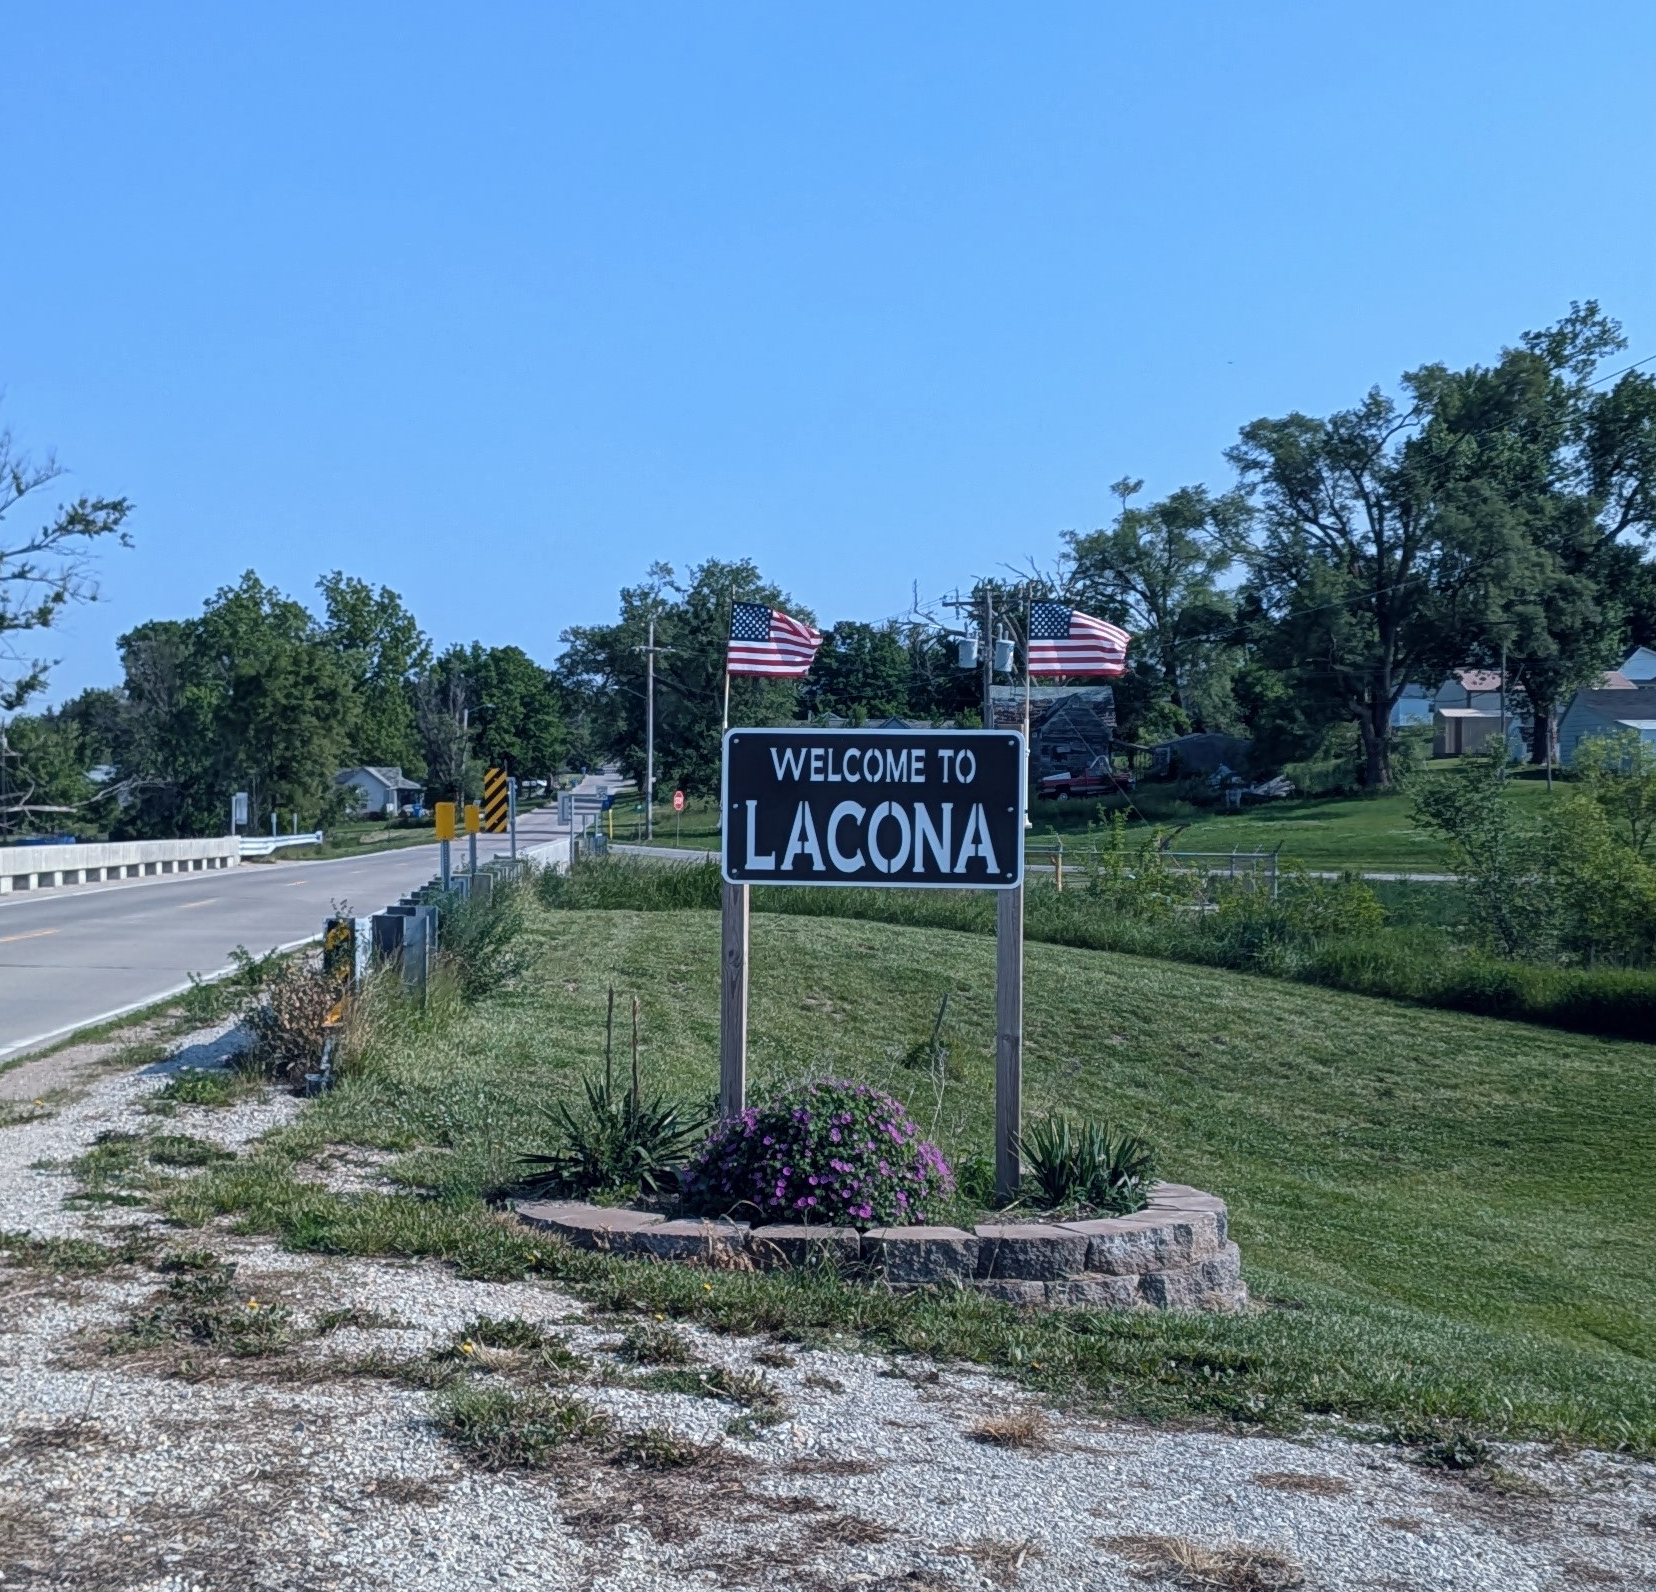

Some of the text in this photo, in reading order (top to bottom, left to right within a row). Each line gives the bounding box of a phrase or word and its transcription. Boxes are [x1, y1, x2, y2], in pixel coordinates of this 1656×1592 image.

[770, 748, 976, 783] WELCOME TO
[745, 800, 1000, 873] LACONA
